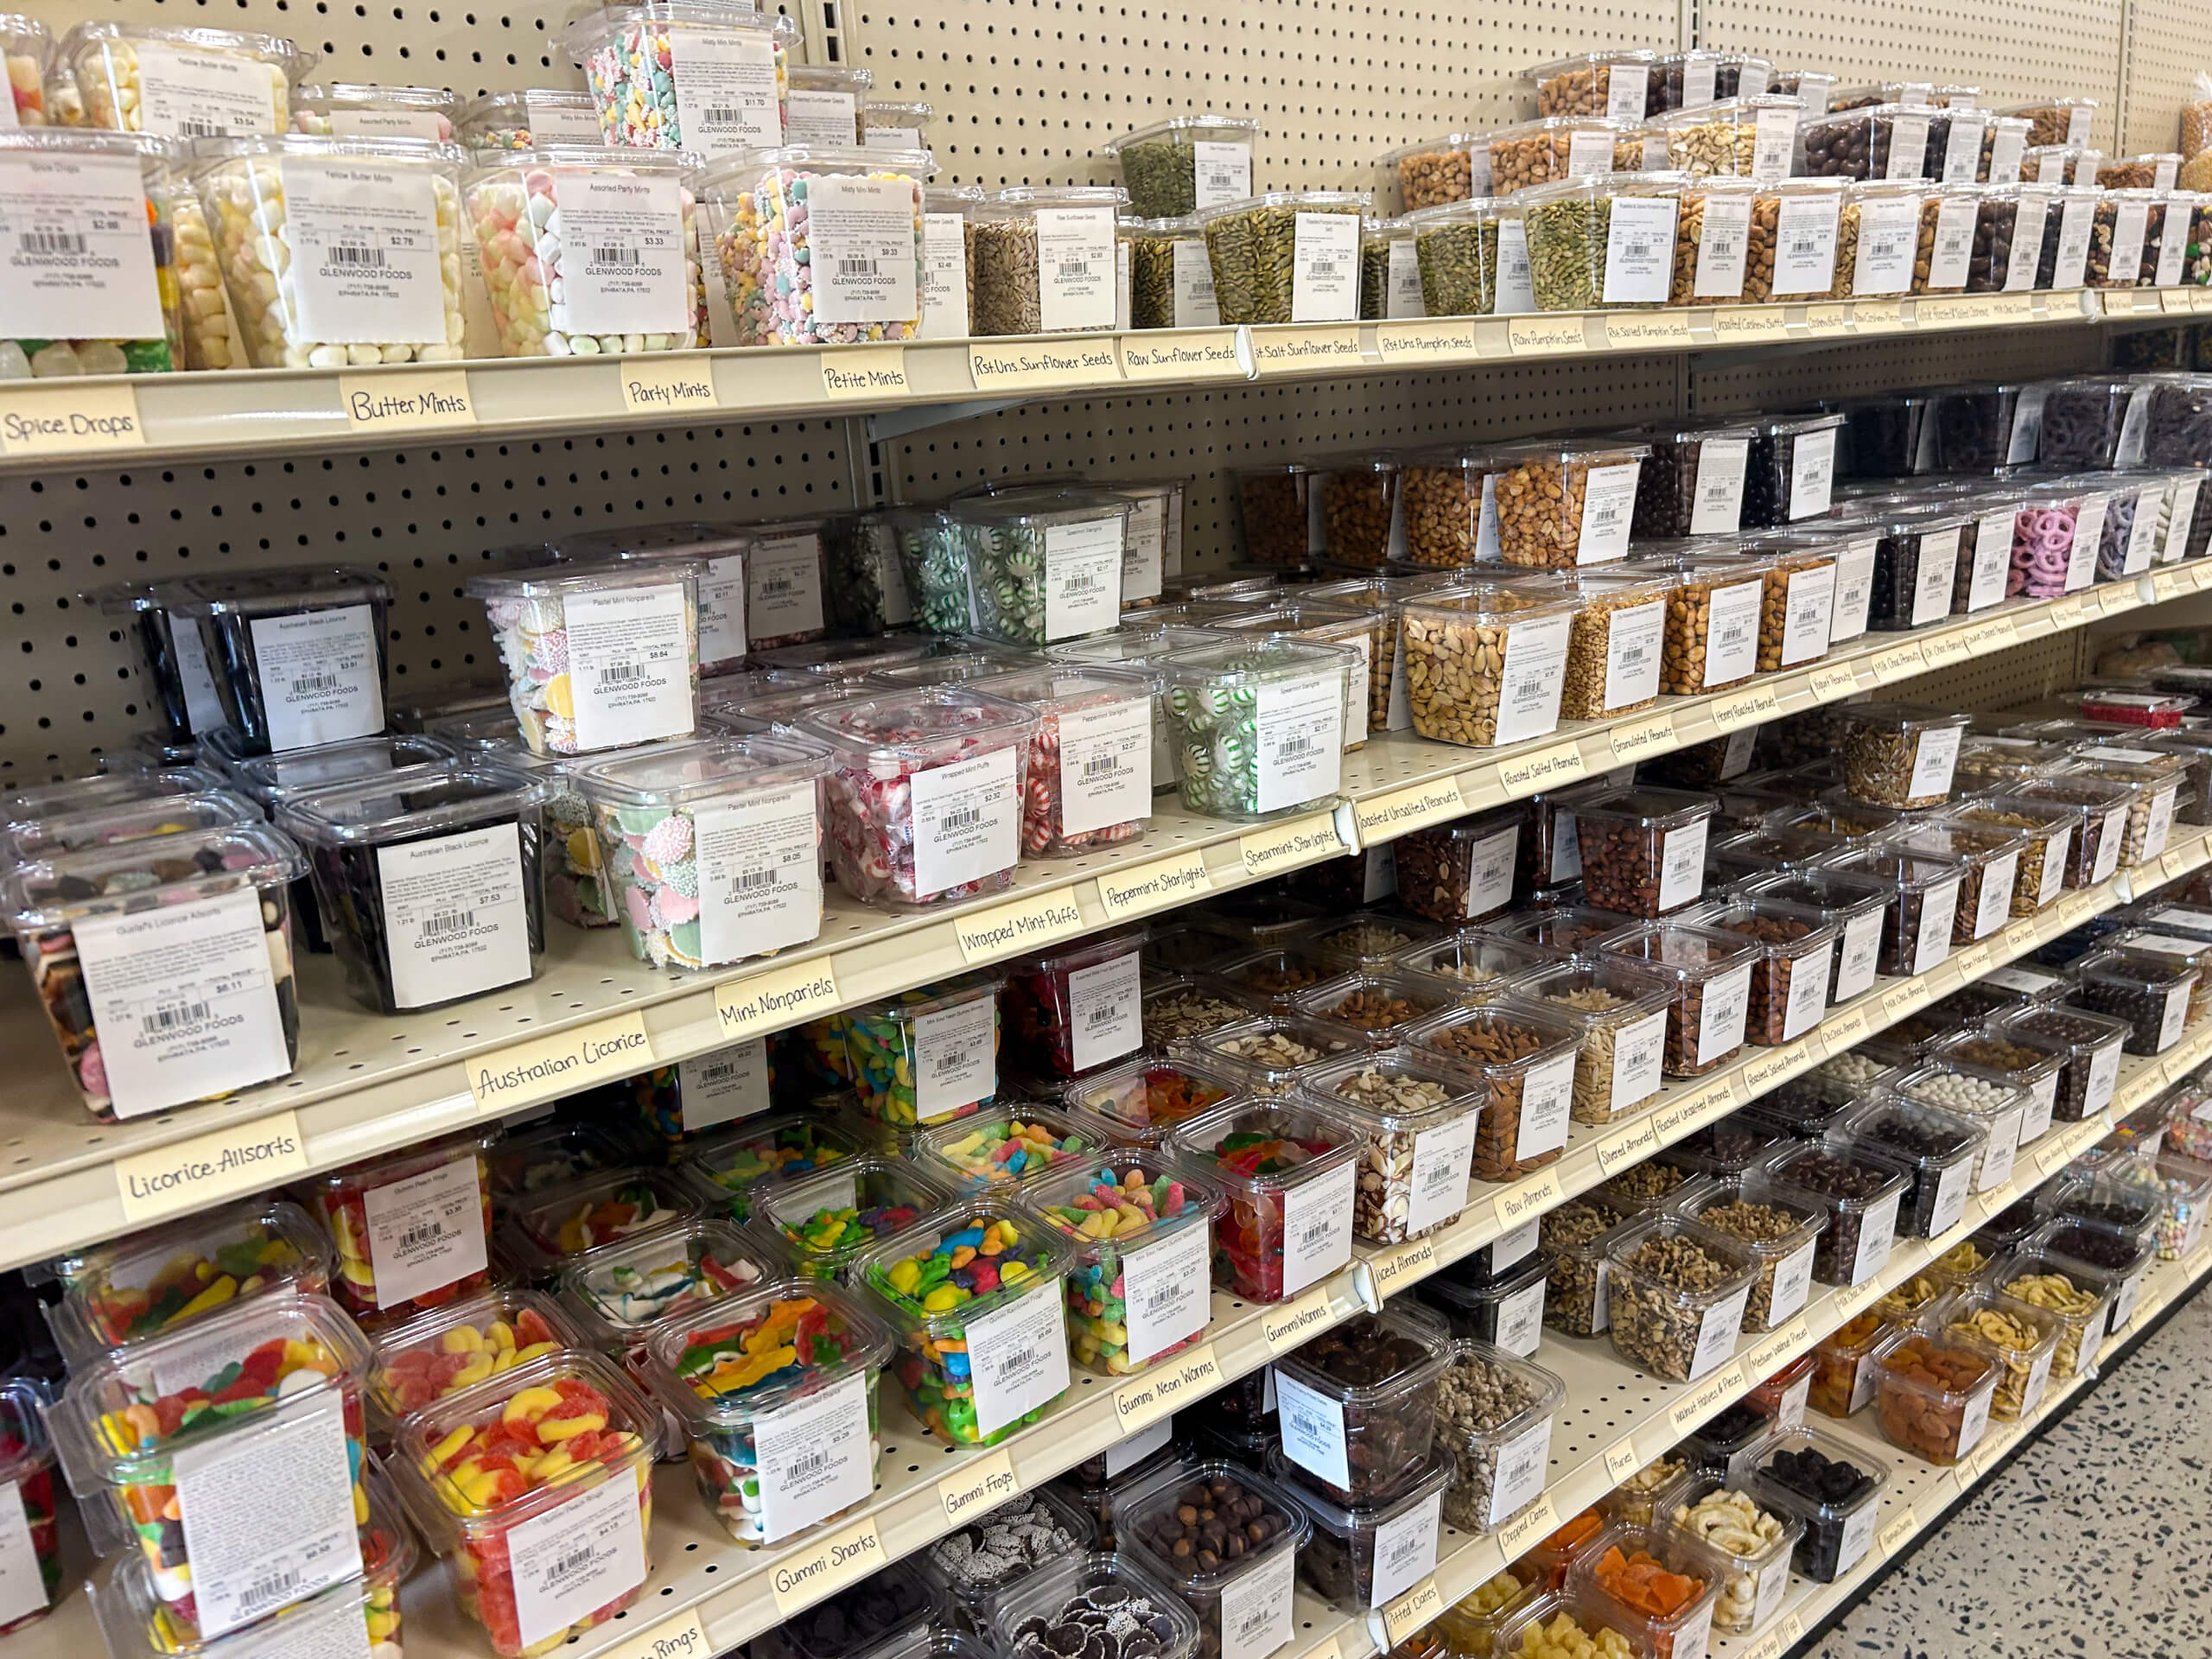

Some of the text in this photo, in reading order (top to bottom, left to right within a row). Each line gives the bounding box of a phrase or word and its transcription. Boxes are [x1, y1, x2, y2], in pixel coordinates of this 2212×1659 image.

[320, 268, 413, 279] GLENWOOD FOODS
[1126, 344, 1236, 366] Raw Sunflower Seeds
[1268, 346, 1287, 359] Salt
[1287, 340, 1332, 357] Sunflower
[1333, 338, 1359, 353] Seeds
[1512, 333, 1530, 346] Raw
[1082, 352, 1113, 366] Seeds
[628, 381, 711, 405] Party Mints
[824, 368, 905, 389] Petite Mints
[351, 391, 467, 421] Butter Mints
[3, 412, 135, 441] Spice Drops
[286, 686, 359, 703] GLENWOOD FOODS
[594, 678, 667, 695] GLENWOOD FOODS
[1716, 696, 1777, 727] Honey Roasted Peanuts
[1612, 726, 1674, 754] Granulated Peanuts
[1273, 747, 1325, 766] GLENWOOD FOODS
[1503, 753, 1580, 788] Roasted Salted Peanuts
[1077, 766, 1134, 786] GLENWOOD FOODS
[985, 792, 1001, 802] $2.32
[1389, 795, 1426, 822] Unsalted
[1424, 790, 1459, 812] Peanuts
[933, 818, 999, 843] GLENWOOD FOODS
[410, 838, 489, 859] Australian Black Licorice
[1245, 828, 1336, 868] Spearmint Starlights
[724, 881, 798, 905] GLENWOOD FOODS
[1106, 863, 1206, 906] Peppermint Starlights
[414, 924, 499, 950] GLENWOOD FOODS
[963, 904, 1079, 950] Wrapped Mint Puffs
[719, 977, 835, 1027] Mint Nonpariels
[133, 1014, 245, 1050] GLENWOOD FOODS
[476, 1030, 646, 1100] Australian Licorice
[1747, 1047, 1806, 1088] Roasted Salted Almonds
[1656, 1086, 1731, 1135] Roasted Unsalted Almonds
[1626, 1128, 1653, 1153] Almonds
[128, 1135, 296, 1200] Licorice Allsorts
[1505, 1182, 1552, 1217] Raw Almonds
[392, 1229, 462, 1260] GLENWOOD FOODS
[1397, 1246, 1433, 1273] Almonds
[1141, 1298, 1176, 1319] GLENWOOD
[1266, 1304, 1327, 1342] Gummi Worms
[994, 1351, 1052, 1387] GLENWOOD FOODS
[1118, 1359, 1215, 1415] Gummi Neon Worms
[1673, 1371, 1743, 1425] Walnut Halves Pieces
[780, 1455, 849, 1491] GLENWOOD FOODS
[1608, 1452, 1632, 1472] Prunes
[945, 1468, 1014, 1515] Gummi Frogs
[1501, 1503, 1548, 1548] Chopped Dates
[774, 1535, 877, 1594] Gummi Sharks
[1388, 1586, 1437, 1625] Pitted Dates
[652, 1627, 698, 1659] Rings
